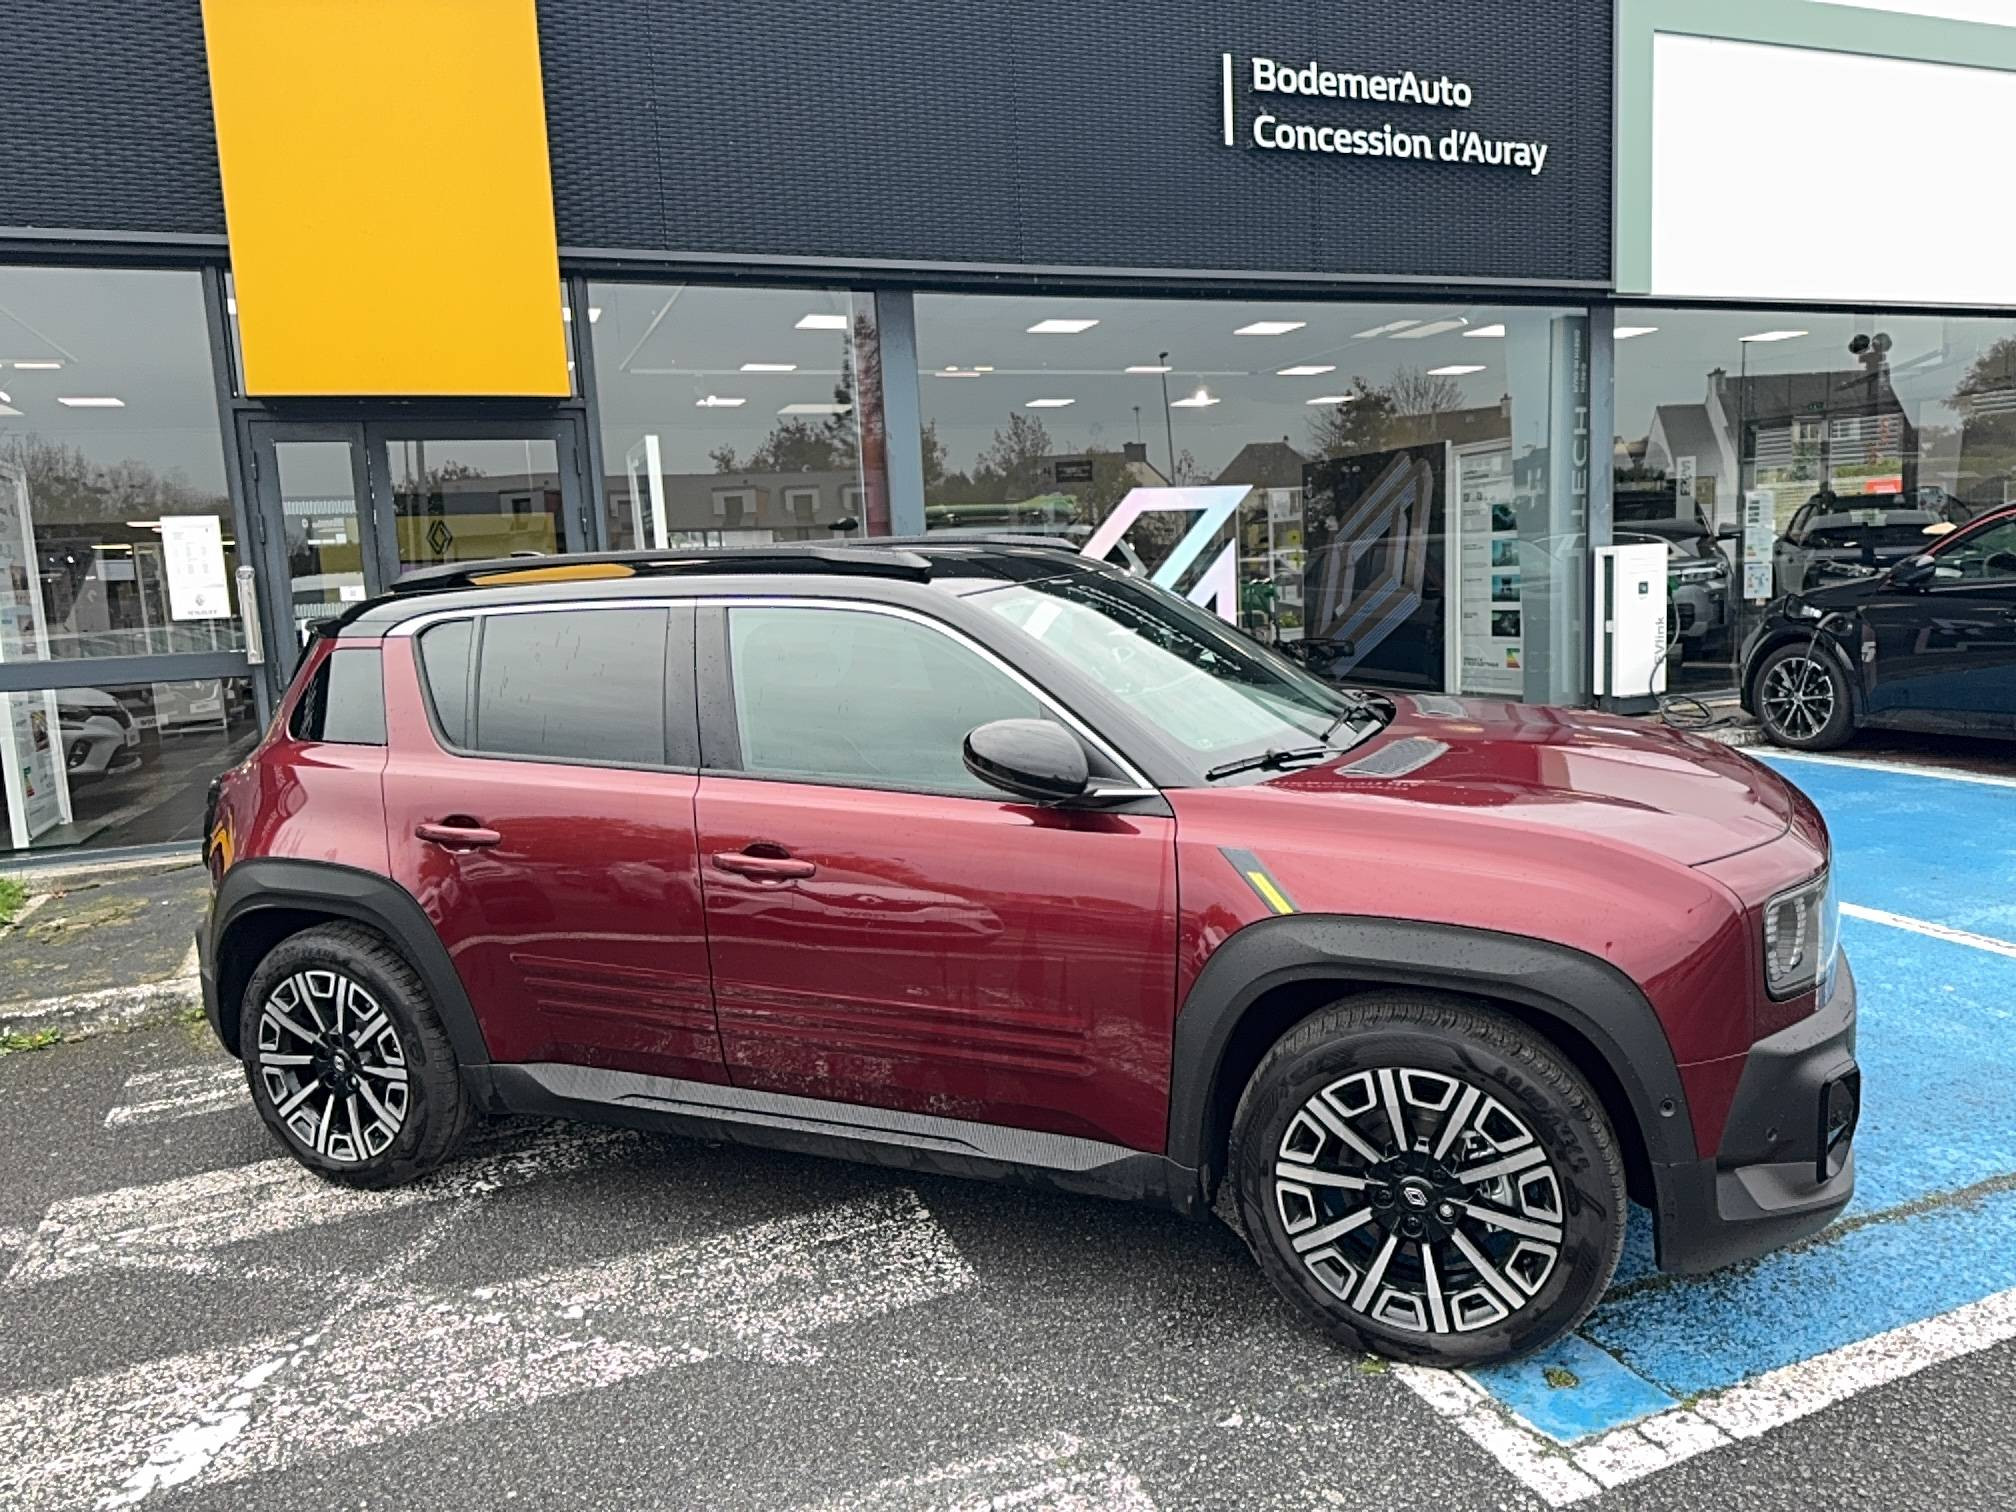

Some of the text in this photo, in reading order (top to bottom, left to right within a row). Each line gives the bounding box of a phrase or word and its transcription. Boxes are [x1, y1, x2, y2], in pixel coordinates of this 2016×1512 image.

[1251, 56, 1472, 108] BodemerAuto
[1253, 115, 1547, 175] Concession d'Auray
